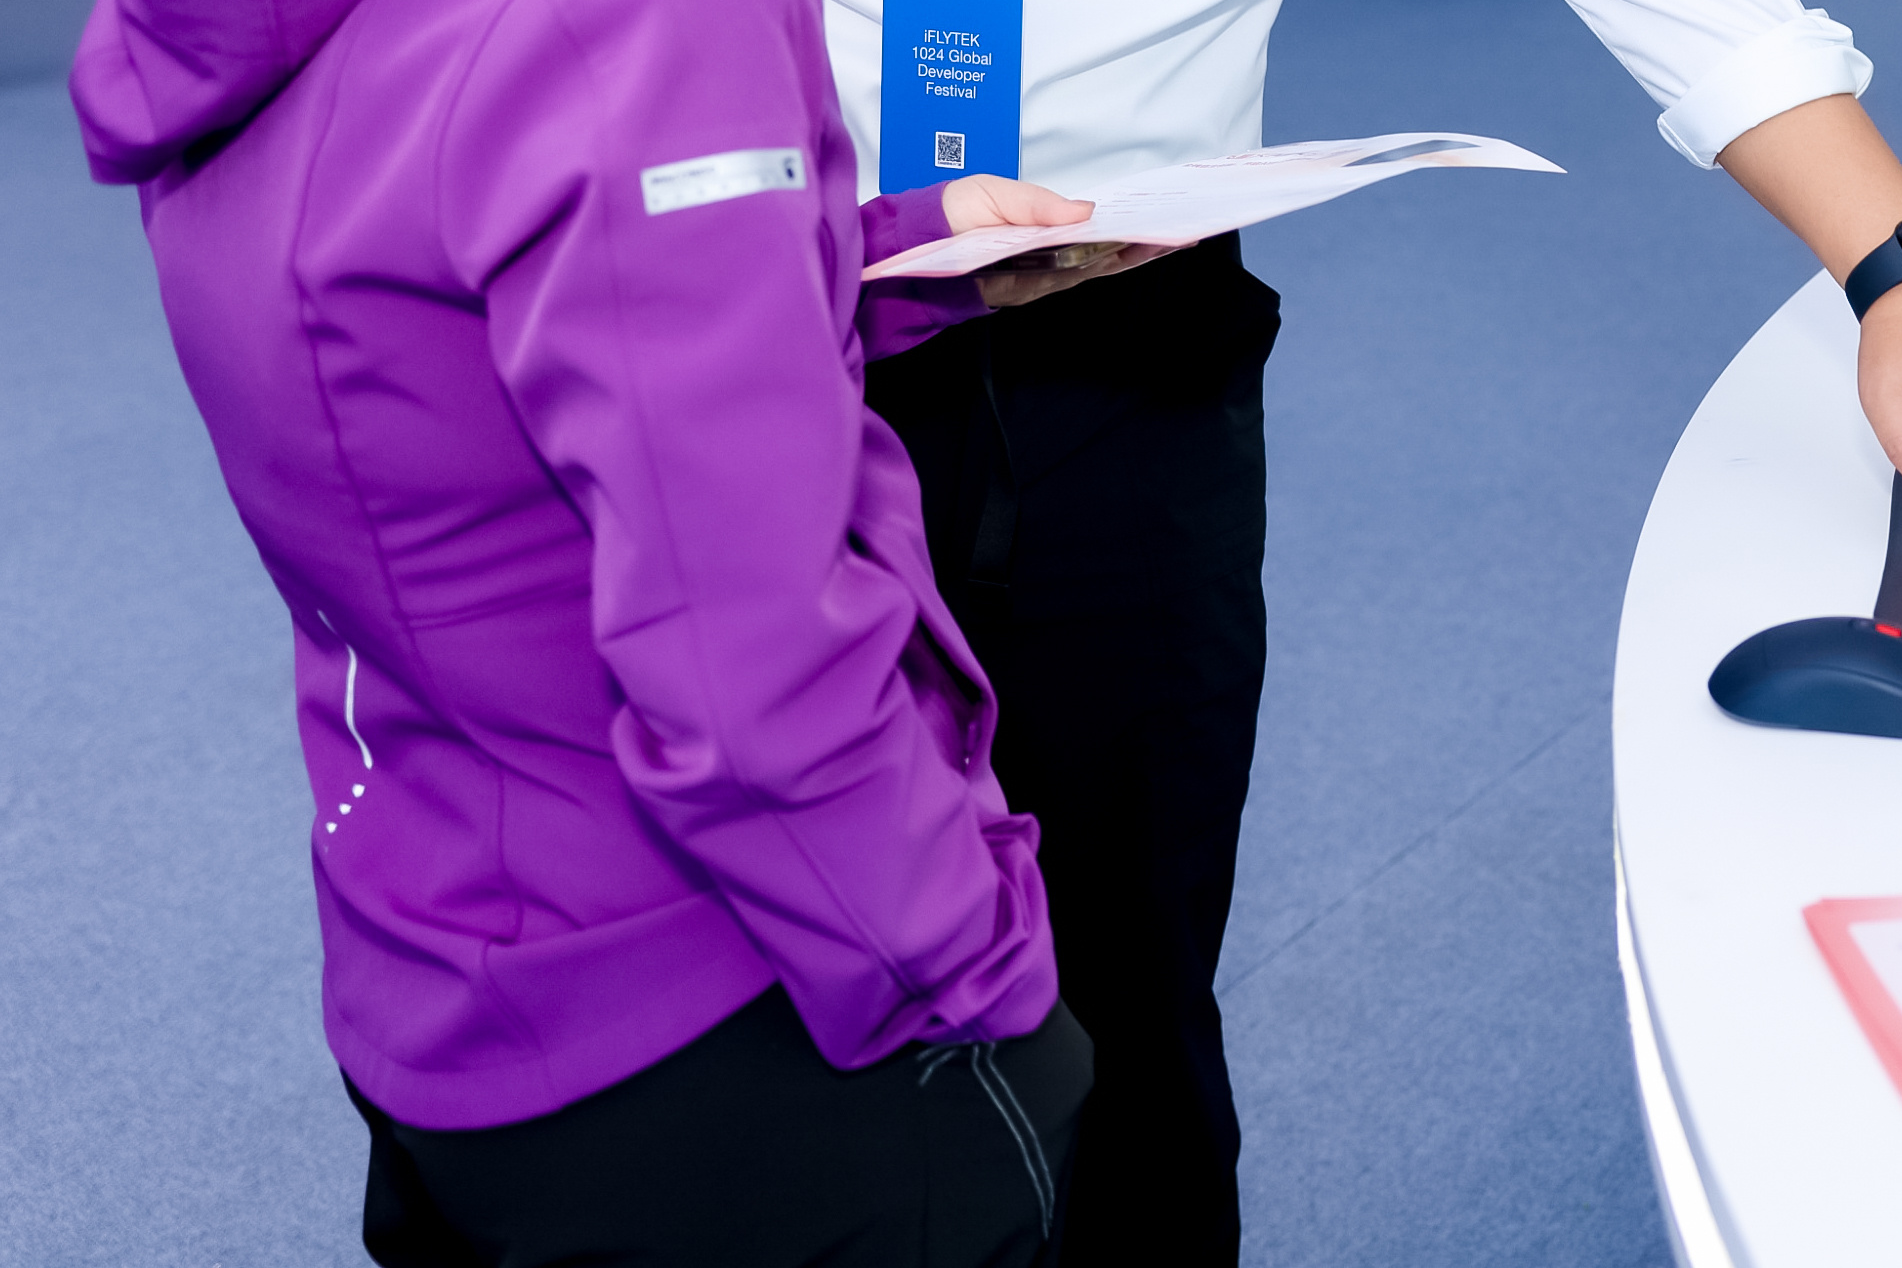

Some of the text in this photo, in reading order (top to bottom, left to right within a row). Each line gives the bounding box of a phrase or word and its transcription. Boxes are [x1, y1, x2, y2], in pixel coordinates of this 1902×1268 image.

[924, 29, 980, 48] iFLYTEK
[912, 46, 992, 66] 1024 Global
[917, 63, 986, 84] Developer
[926, 81, 977, 100] Festival
